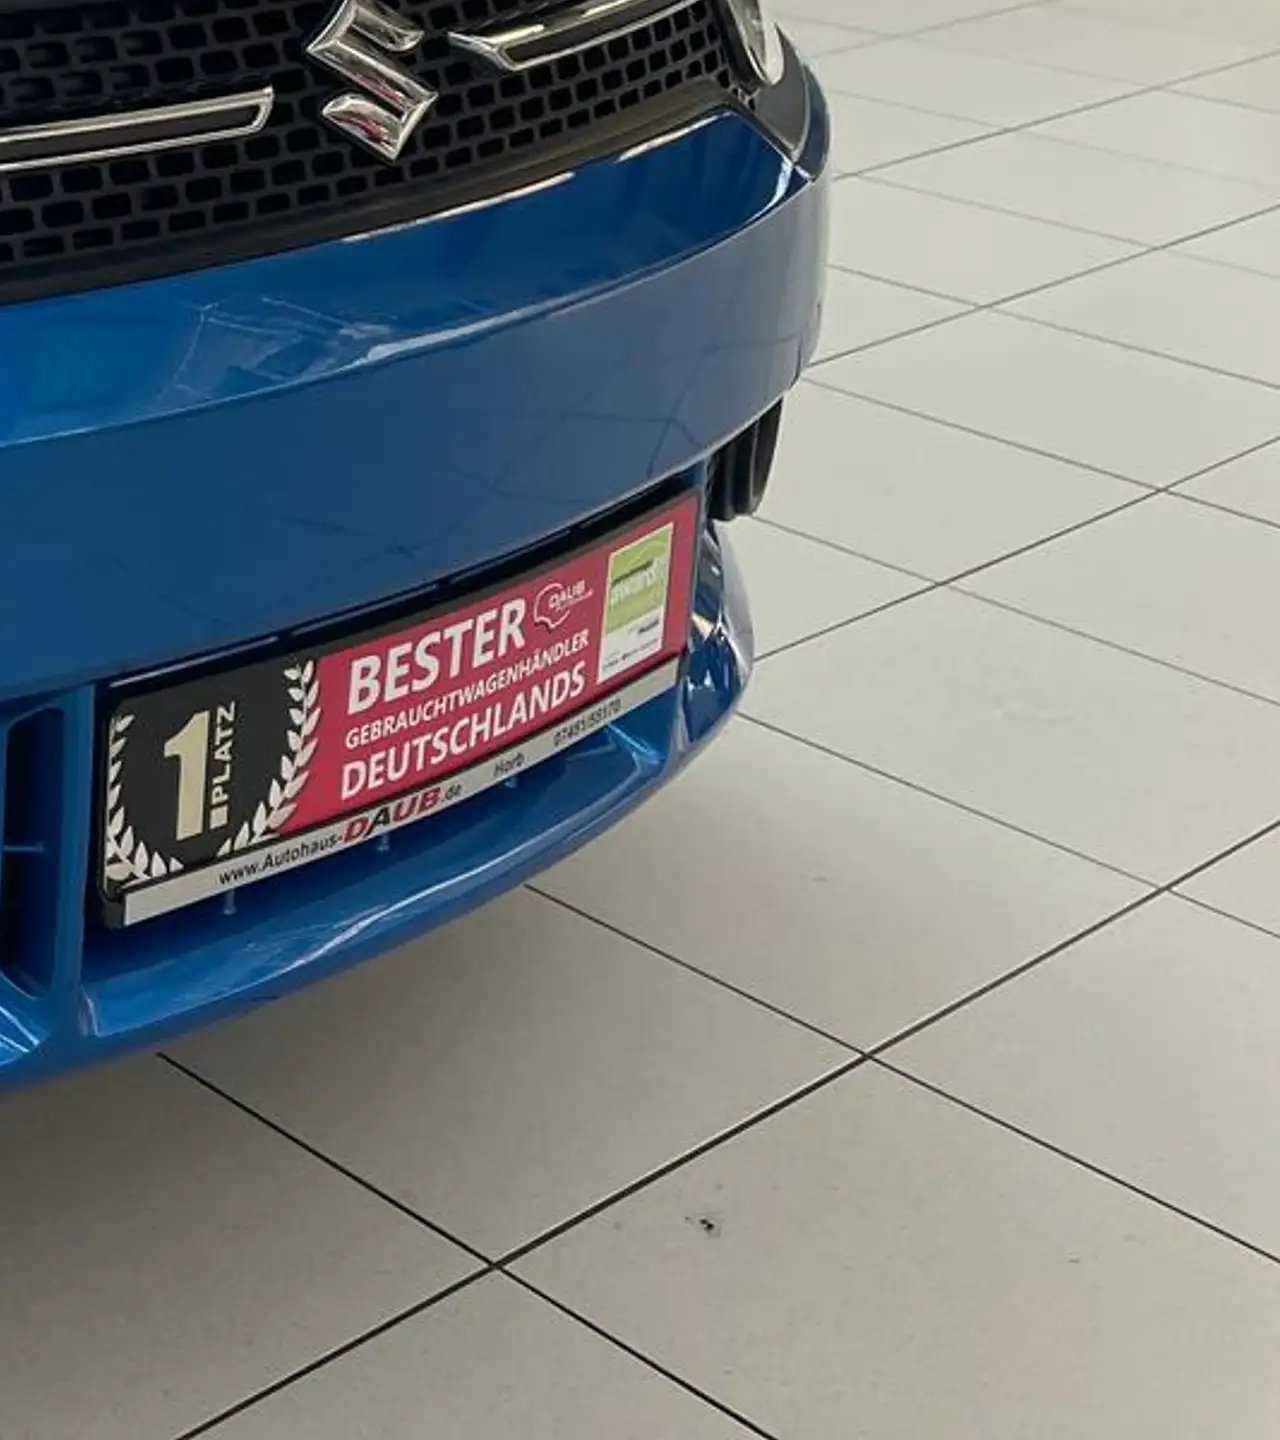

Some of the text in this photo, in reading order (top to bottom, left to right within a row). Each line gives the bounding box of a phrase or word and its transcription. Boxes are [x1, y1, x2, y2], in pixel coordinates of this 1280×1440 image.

[344, 630, 590, 750] GEBRAUCHTWAGENHÄNDLER
[346, 596, 527, 715] BESTER
[211, 701, 236, 808] PLATZ
[341, 661, 586, 800] DEUTSCHLANDS
[494, 753, 525, 781] Horb
